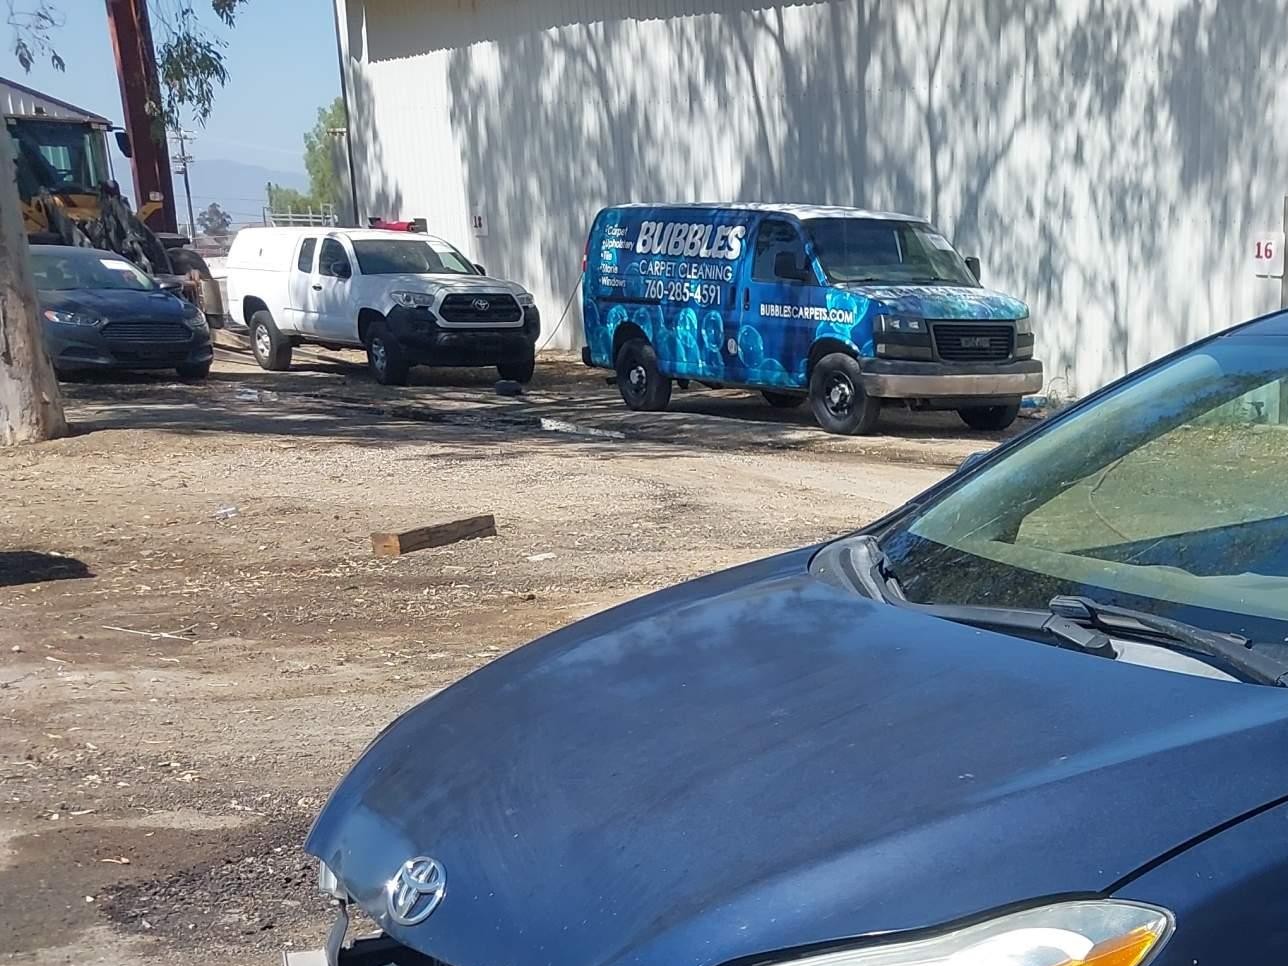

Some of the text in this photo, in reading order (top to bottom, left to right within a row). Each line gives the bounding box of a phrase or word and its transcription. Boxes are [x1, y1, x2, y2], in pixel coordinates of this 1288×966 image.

[473, 215, 483, 229] 18
[636, 221, 746, 260] BUBBLES
[1255, 241, 1273, 259] 16
[639, 259, 733, 281] CARPET CLEANING
[644, 280, 721, 304] 760-285-4591
[760, 303, 853, 324] BUBBLESCARPETS.COM
